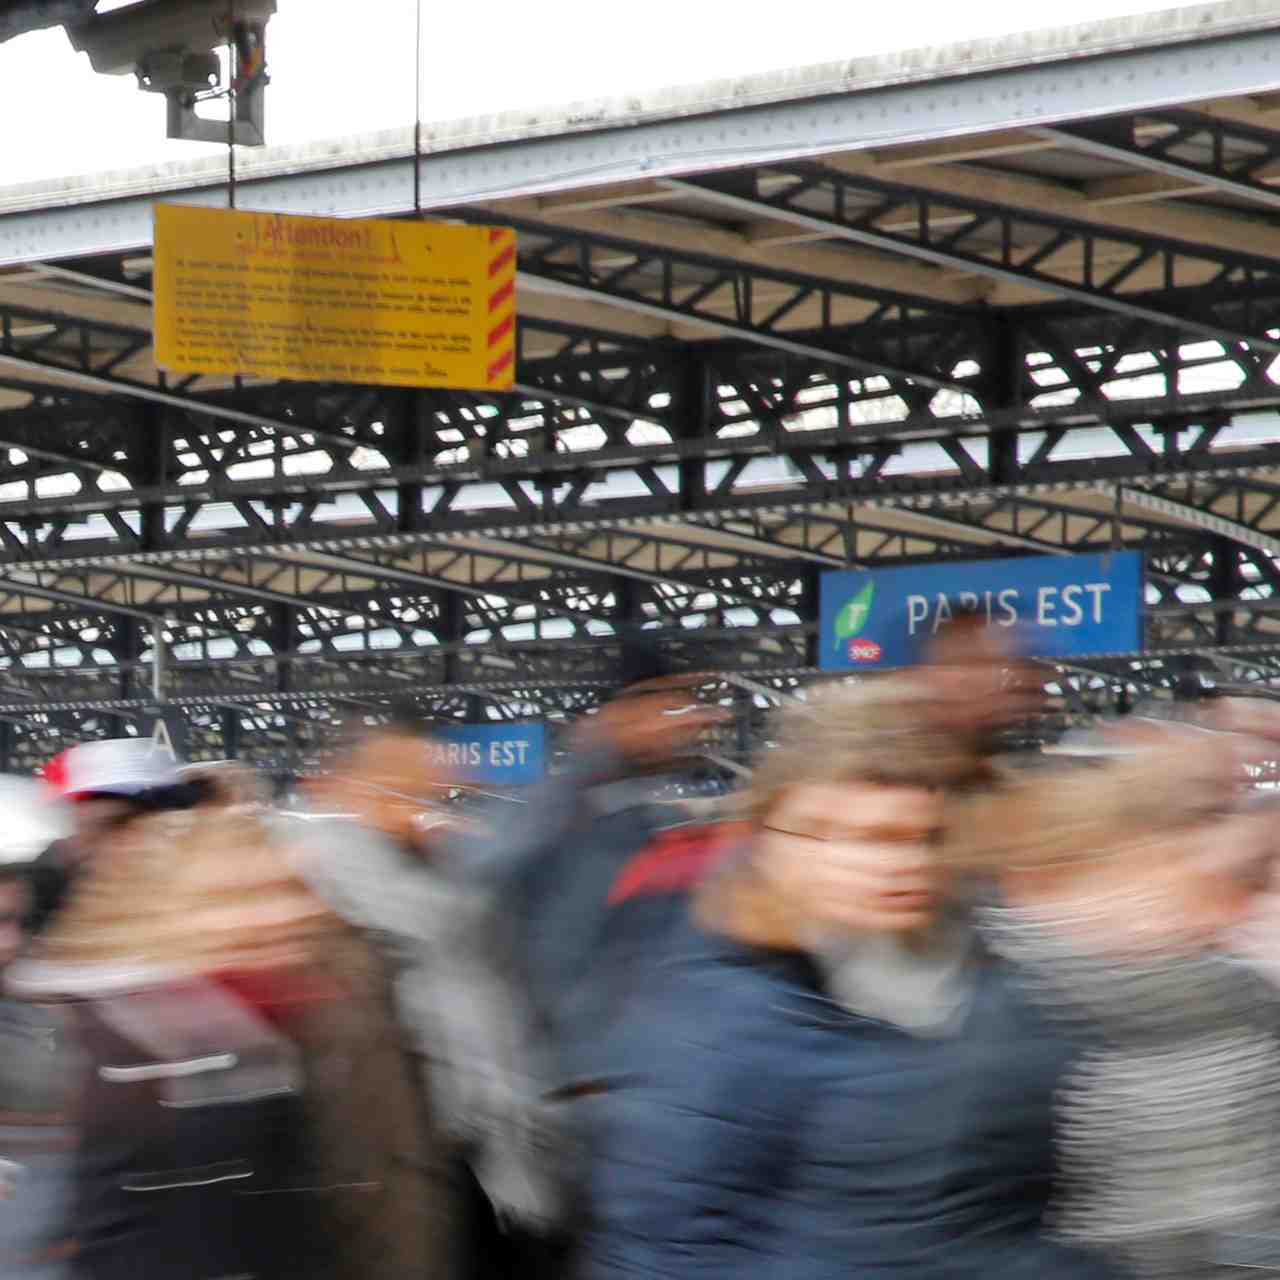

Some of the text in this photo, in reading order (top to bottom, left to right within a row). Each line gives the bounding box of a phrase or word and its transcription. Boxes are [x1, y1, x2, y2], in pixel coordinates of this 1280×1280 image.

[1036, 582, 1111, 627] EST
[424, 740, 530, 767] ARIS EST
